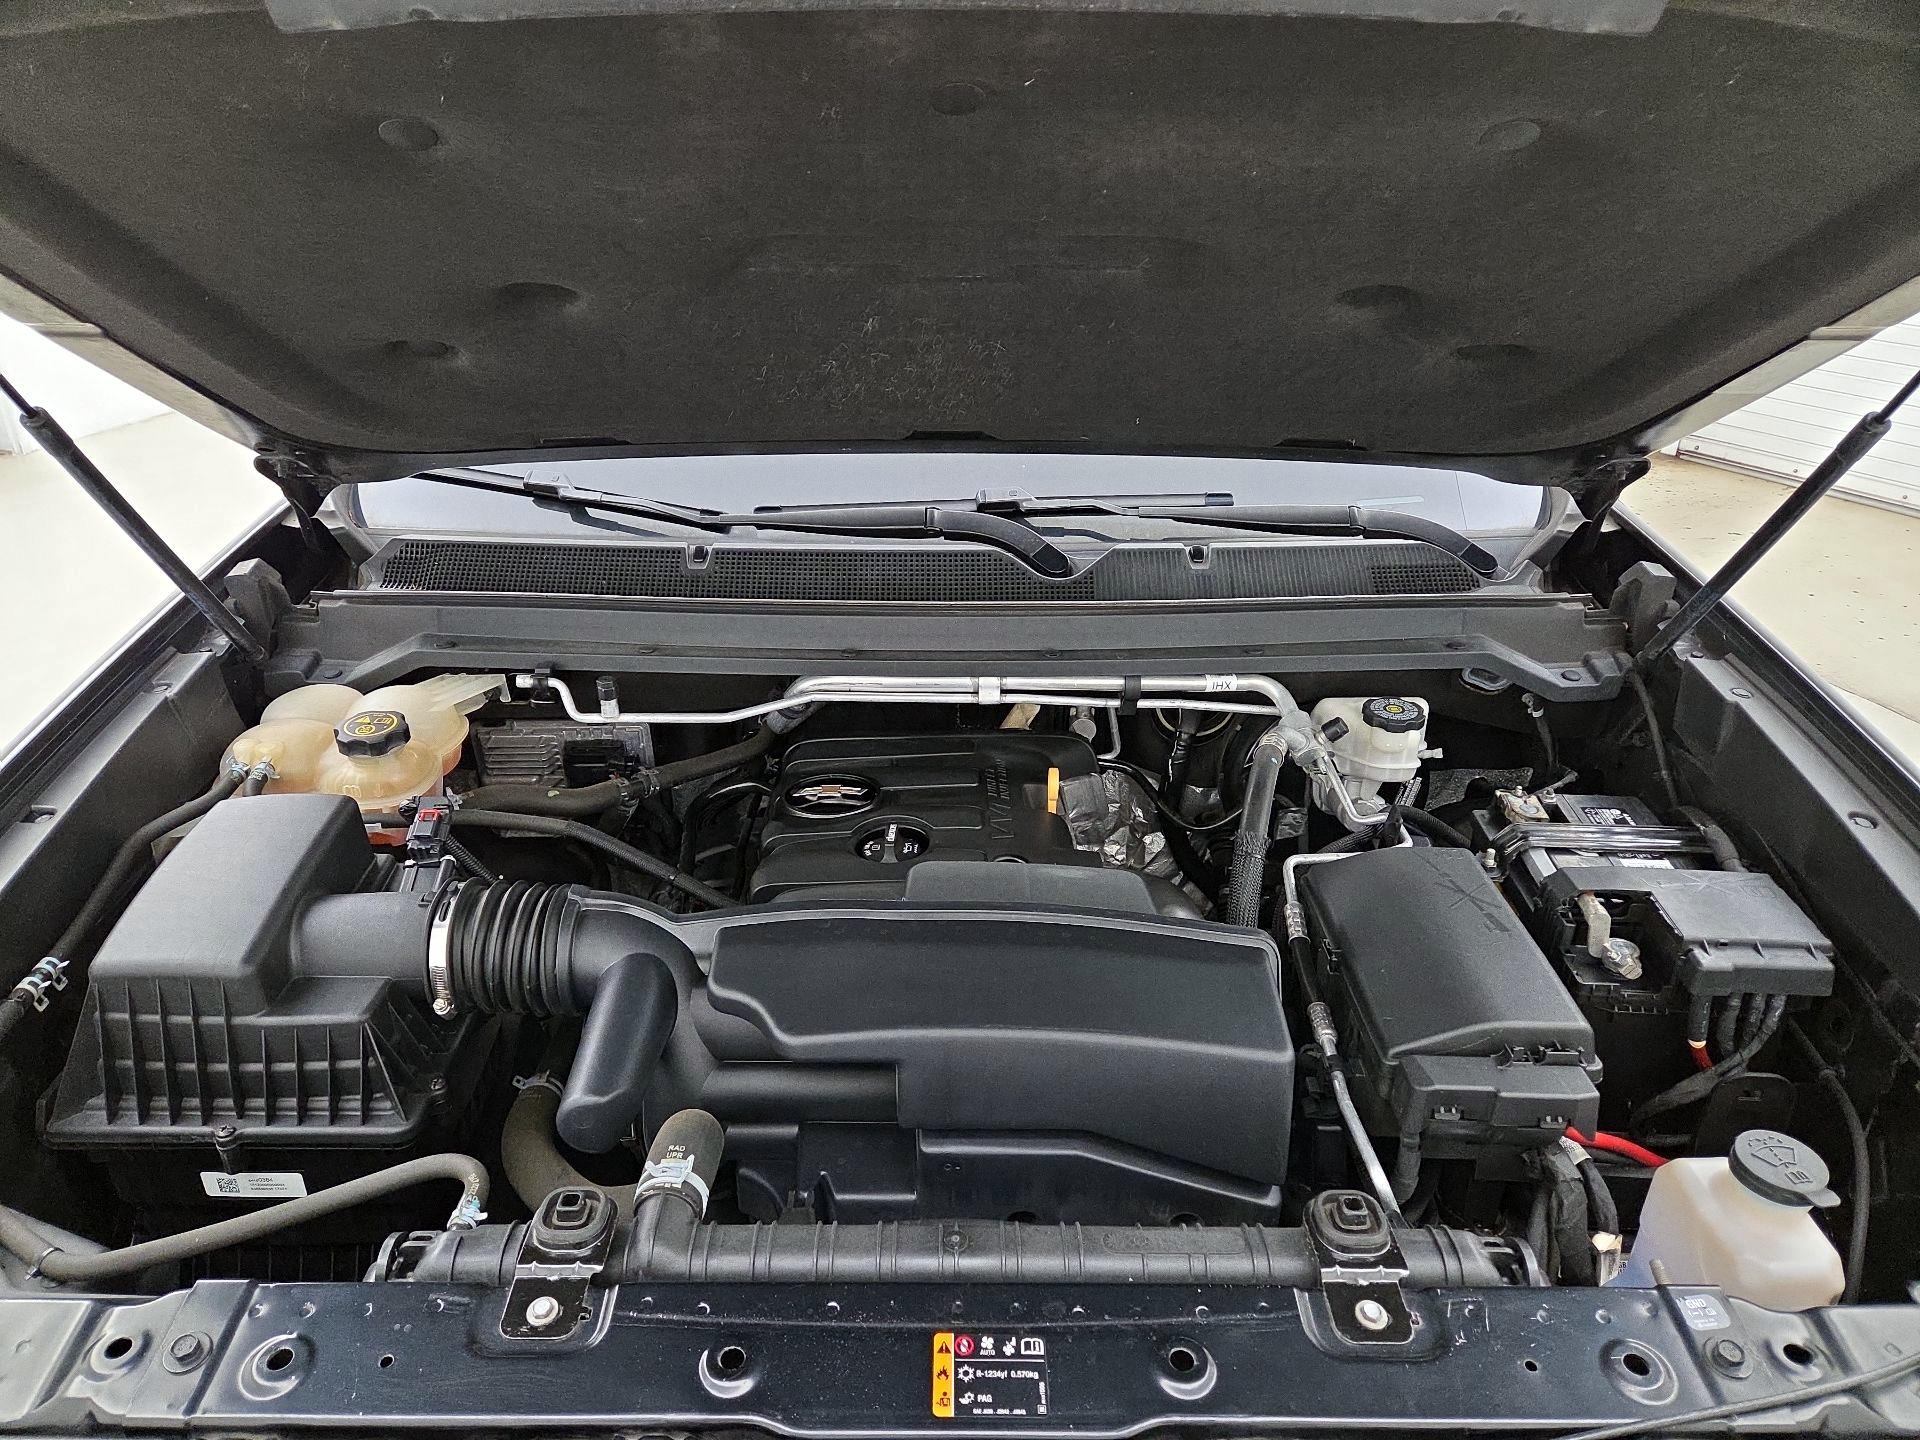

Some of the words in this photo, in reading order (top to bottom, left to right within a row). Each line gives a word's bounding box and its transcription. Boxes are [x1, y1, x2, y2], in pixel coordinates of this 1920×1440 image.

[1212, 681, 1232, 690] IHX
[1685, 1298, 1707, 1309] GND
[1010, 1370, 1039, 1379] 0.570kg
[977, 1394, 993, 1403] PAG
